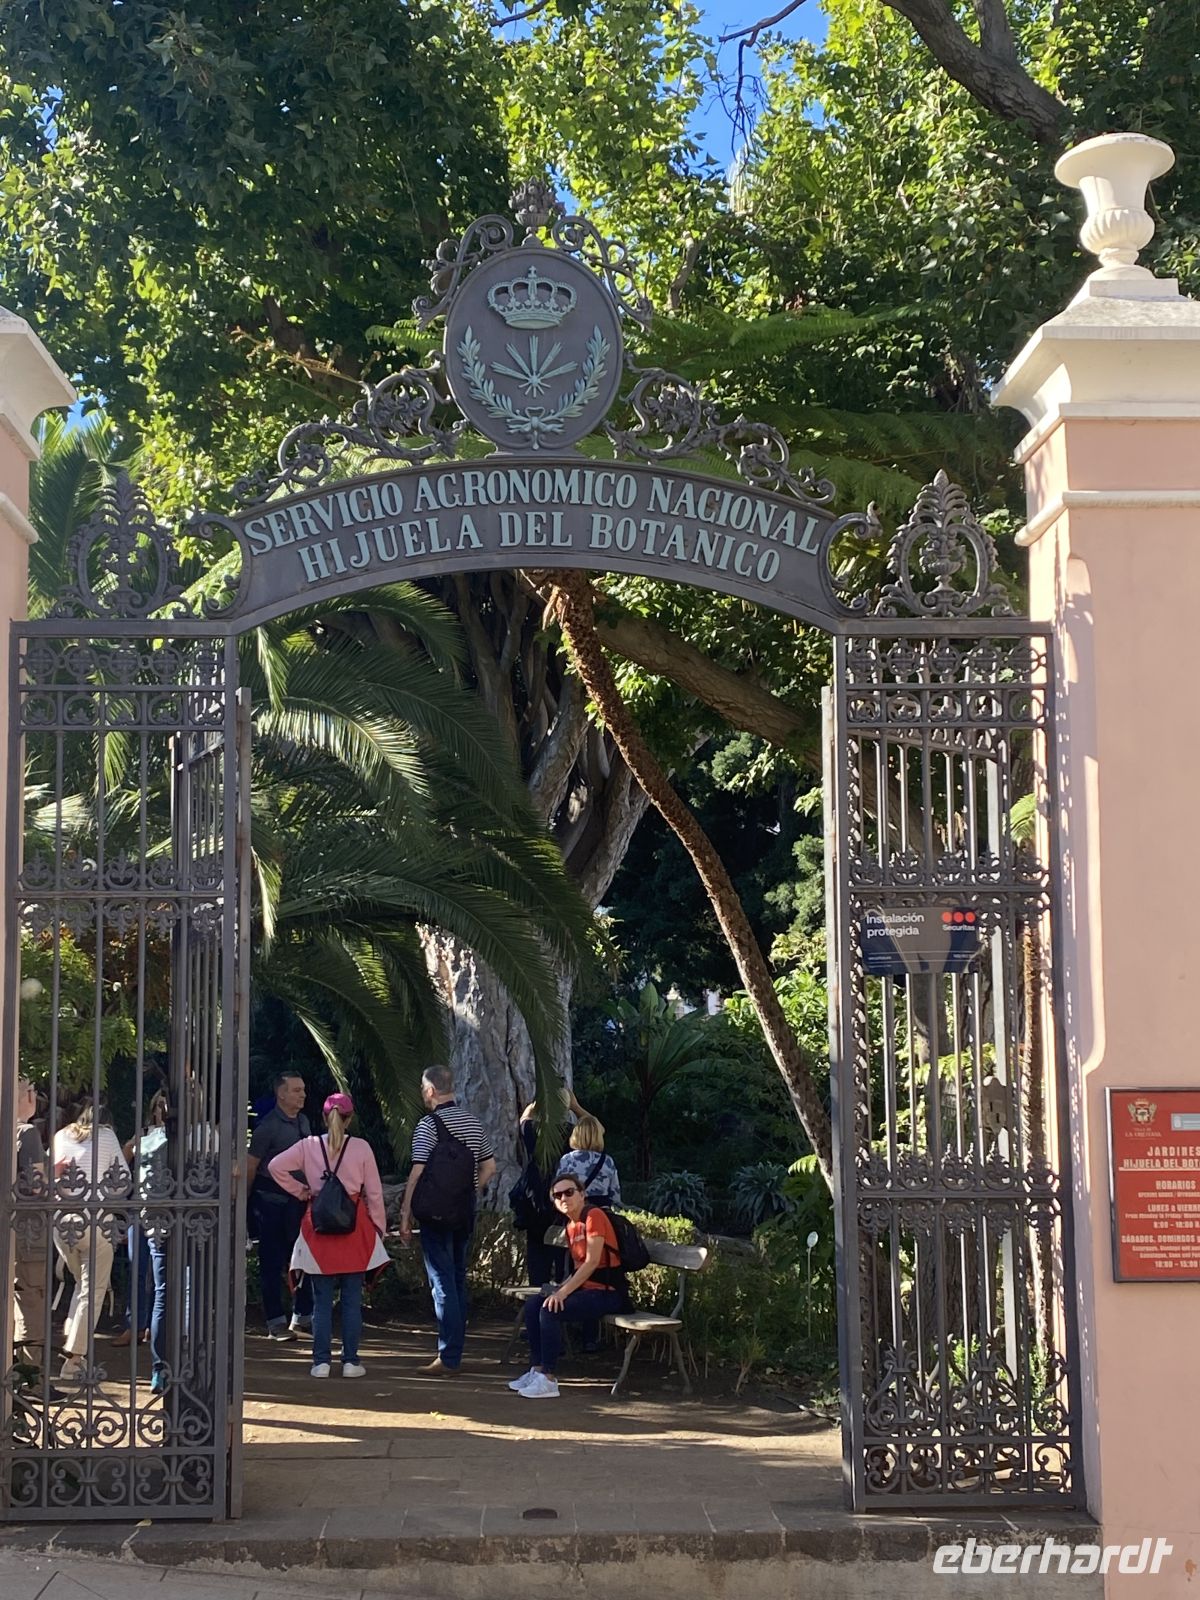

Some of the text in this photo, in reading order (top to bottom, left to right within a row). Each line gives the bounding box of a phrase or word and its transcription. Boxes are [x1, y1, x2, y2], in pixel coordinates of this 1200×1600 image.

[244, 468, 820, 556] SERVICIO AGRONOMICO NACIONAL
[298, 511, 780, 583] HIJUELA DEL BOTANICO
[866, 911, 925, 924] Instalación
[867, 926, 920, 939] protegida
[942, 924, 976, 932] Securitas
[1123, 1158, 1161, 1168] HIJUELA
[1163, 1158, 1179, 1168] DEL
[1156, 1180, 1197, 1190] HORARIOS
